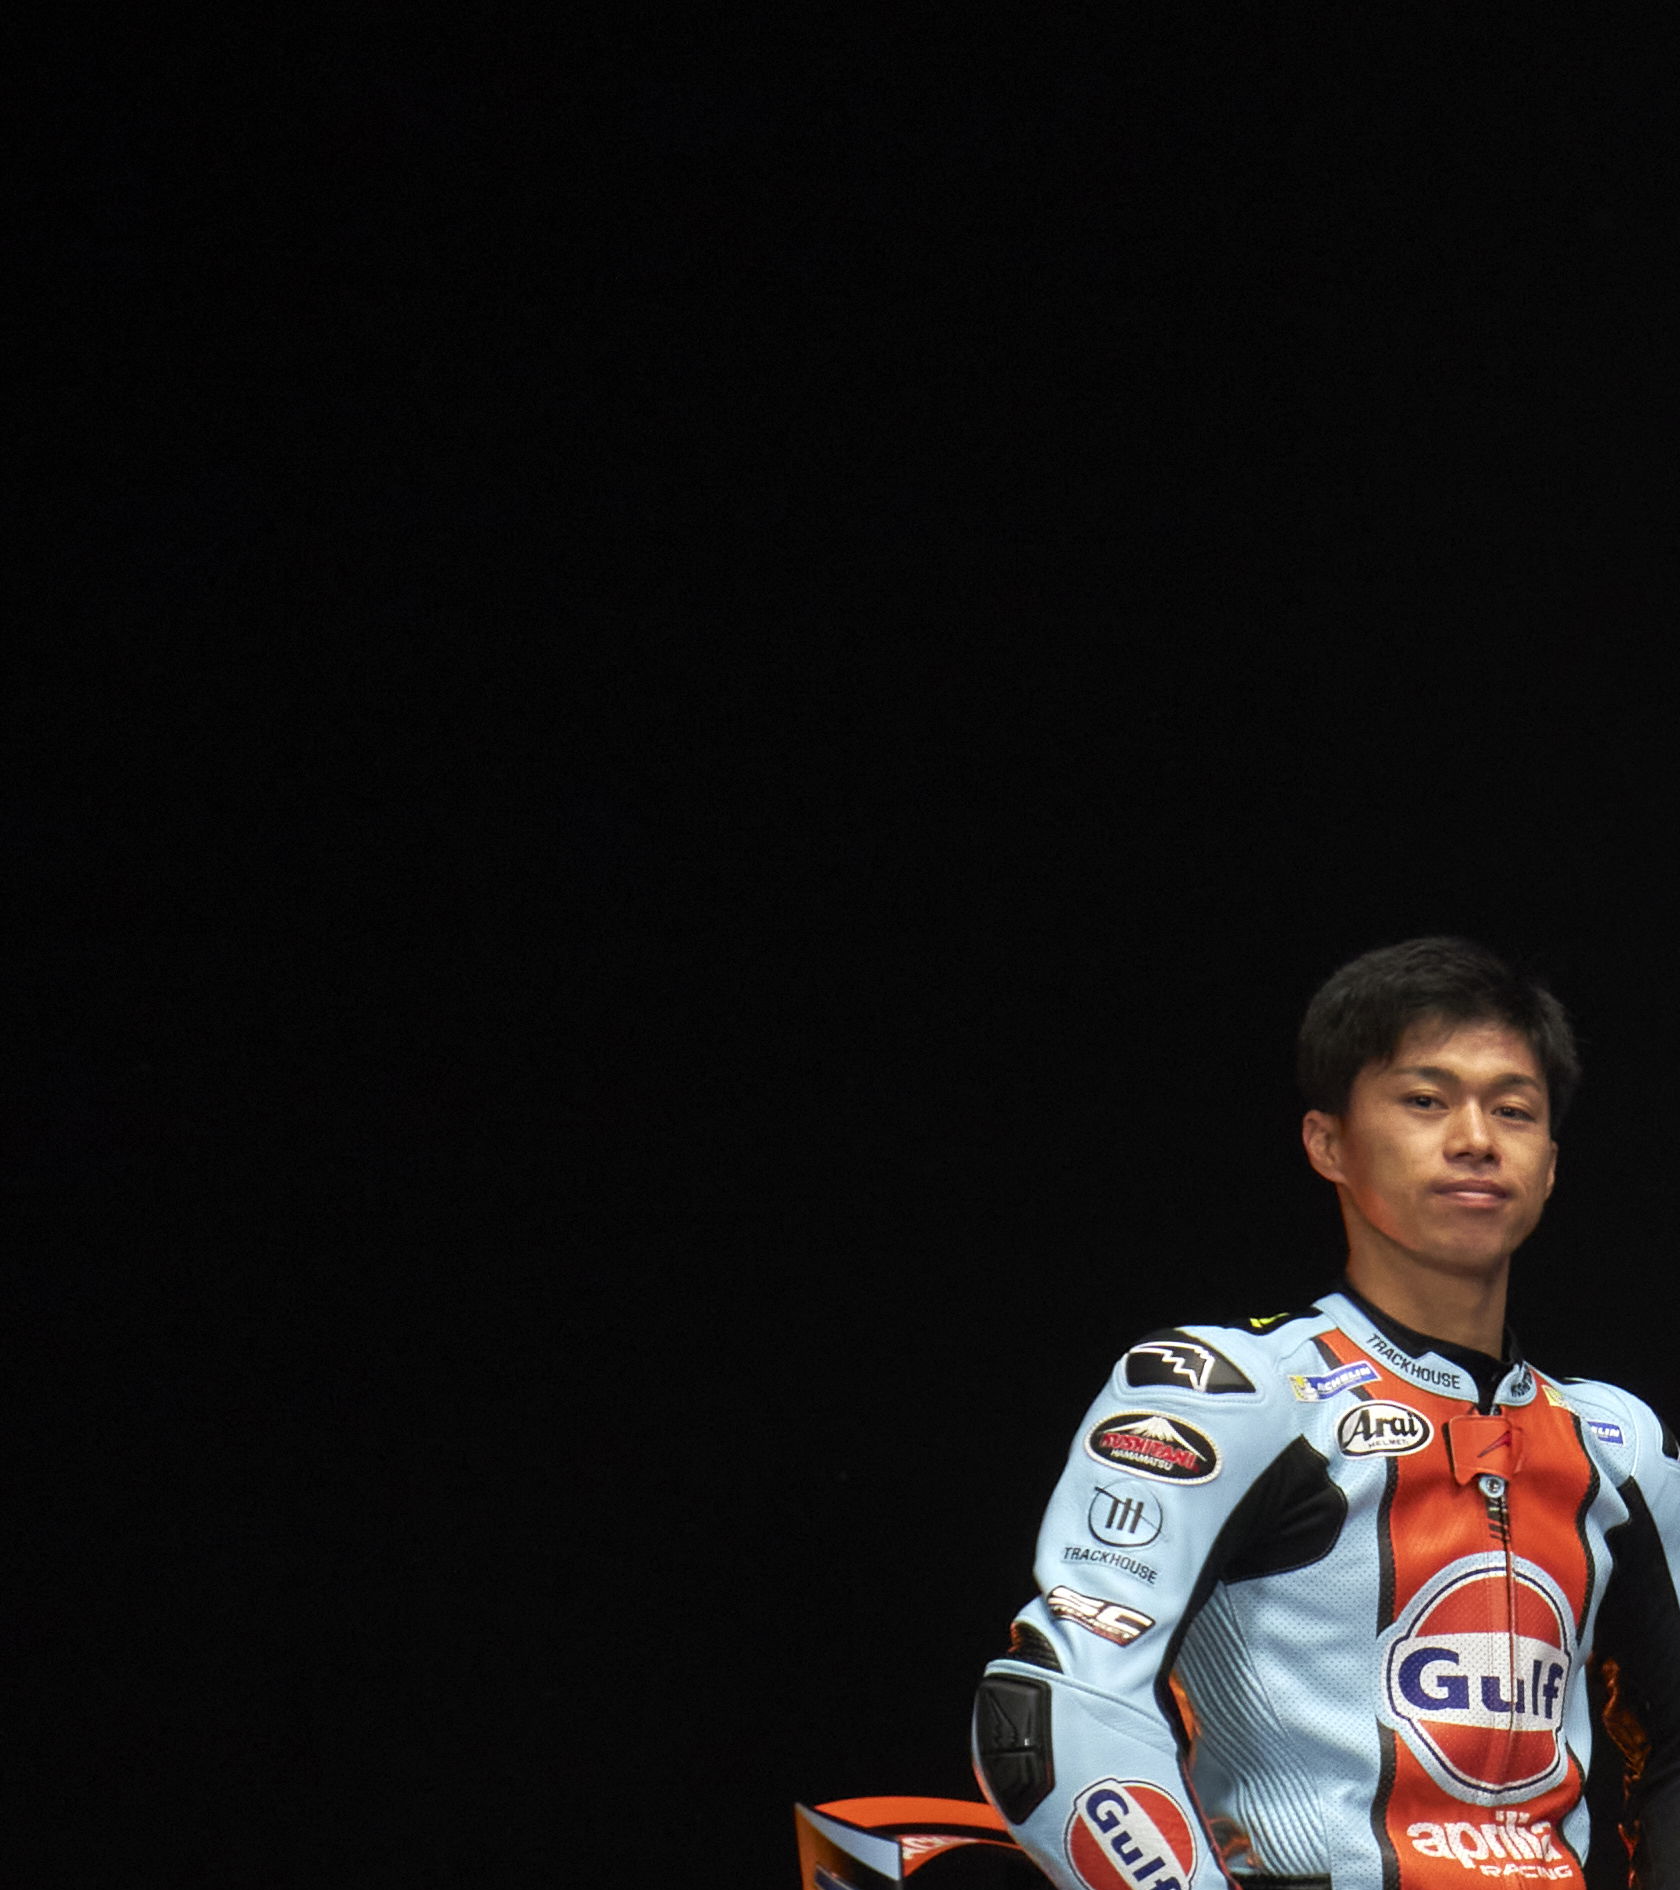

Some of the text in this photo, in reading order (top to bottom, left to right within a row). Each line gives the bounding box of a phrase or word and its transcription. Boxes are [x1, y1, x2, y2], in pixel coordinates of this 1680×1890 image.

[1366, 1333, 1461, 1391] TRACKHOUSE
[1346, 1408, 1419, 1443] Arai
[1063, 1546, 1158, 1585] TRACKHOUSE
[1398, 1646, 1565, 1720] Gulf
